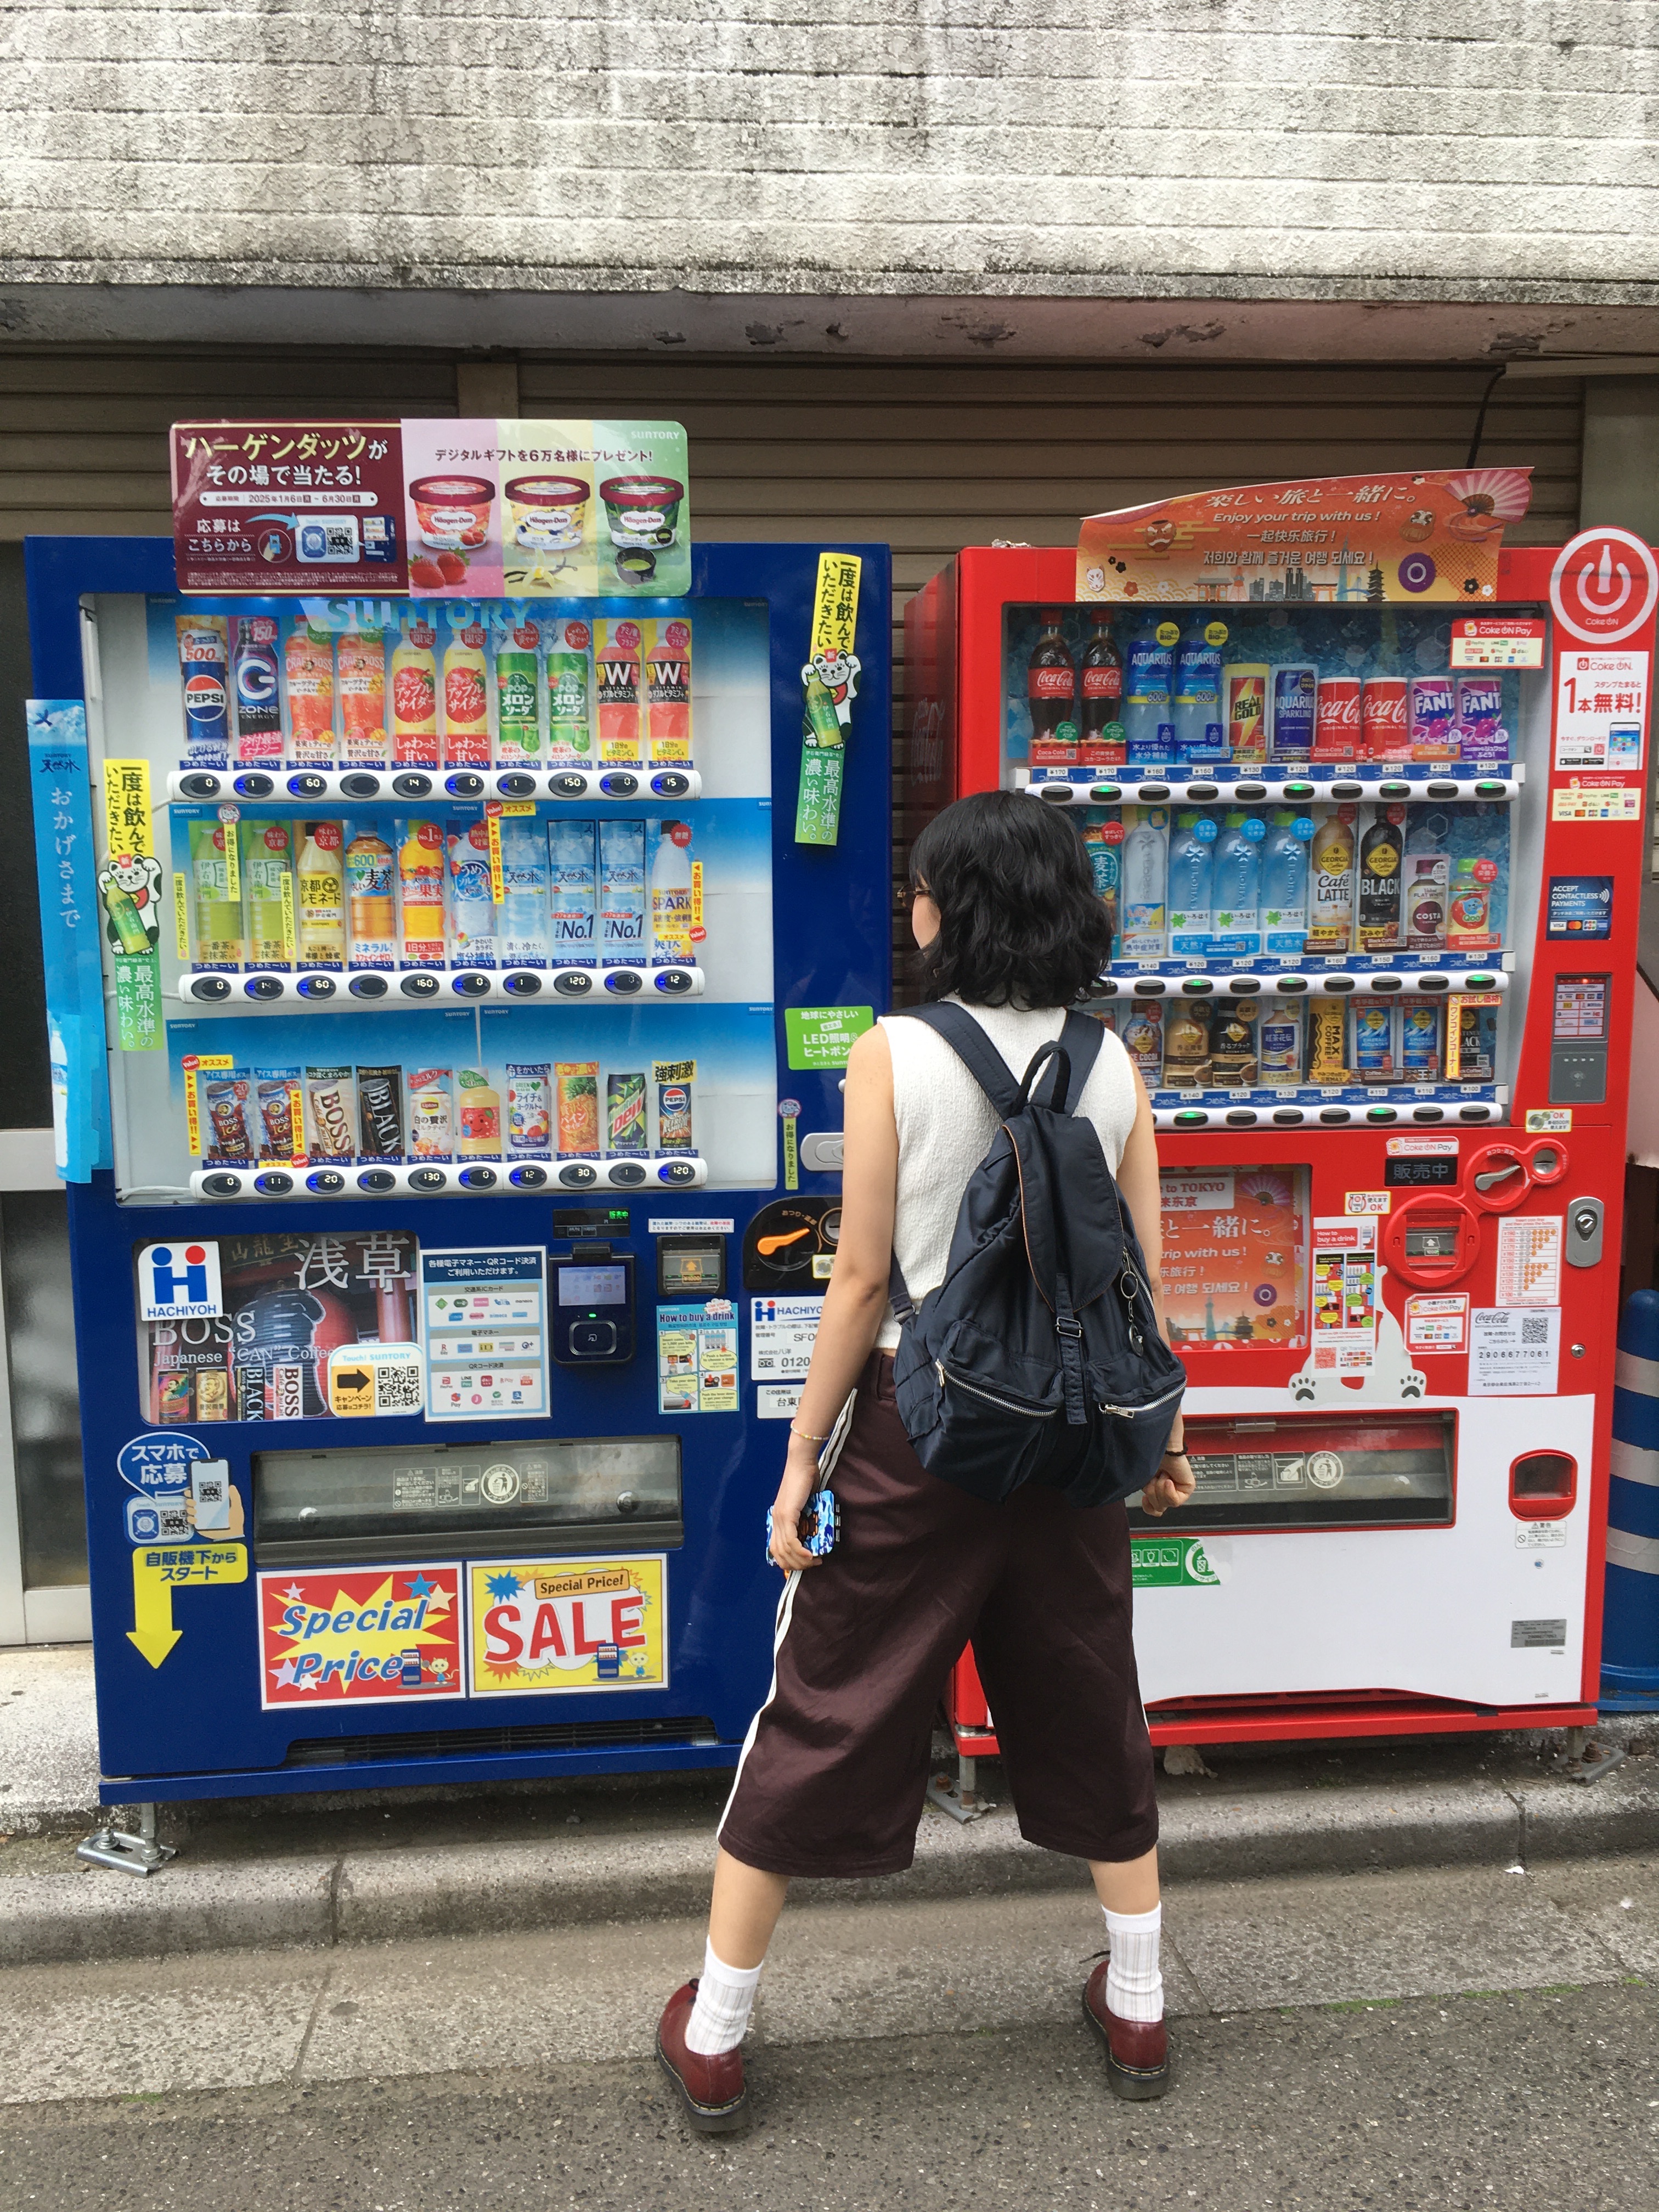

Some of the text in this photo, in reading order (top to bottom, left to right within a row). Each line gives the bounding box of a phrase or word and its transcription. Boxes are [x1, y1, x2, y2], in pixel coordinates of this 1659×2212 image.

[631, 430, 680, 439] SUNTORY
[184, 433, 388, 460] ハーゲンダッツが
[206, 465, 362, 486] その場で当たる!
[1206, 485, 1415, 507] 楽しい旅と一緒に。
[1213, 512, 1250, 524] Enjoy
[1252, 514, 1288, 524] your
[1290, 511, 1316, 523] trip
[1319, 510, 1352, 522] with
[1354, 512, 1372, 521] us
[196, 519, 241, 533] 応募は
[188, 538, 252, 552] こちらから
[1203, 551, 1237, 566] 저희와
[1242, 551, 1264, 566] 함께
[1267, 551, 1301, 565] 즐거운
[1305, 551, 1328, 565] 여행
[1330, 551, 1366, 565] 되세요
[818, 559, 838, 648] いただきたい
[835, 560, 857, 650] 一度は飲んで
[1516, 627, 1532, 636] Pay
[1132, 653, 1172, 666] AQUARIUS
[1180, 653, 1220, 665] AQUARIUS
[605, 664, 630, 685] W
[654, 664, 680, 685] W
[1037, 670, 1073, 687] Coca-Cola
[1084, 670, 1120, 687] Coca-Cola
[187, 693, 224, 703] PEPSI
[397, 696, 435, 713] サイダー
[502, 696, 534, 706] メロン
[552, 696, 585, 706] メロン
[1234, 697, 1261, 712] REAL
[506, 706, 532, 715] ソーダ
[1235, 707, 1261, 721] GOLD
[397, 736, 436, 749] しゅわっと
[447, 737, 488, 749] しゅわっと
[404, 750, 428, 761] 甘い
[1612, 780, 1626, 788] Pay
[803, 758, 822, 841] 濃い味わい。
[821, 759, 840, 843] 最高水準の
[106, 766, 123, 854] いただきたい
[121, 767, 146, 853] 一度は飲んで
[51, 787, 81, 928] おかげさまで
[227, 831, 238, 894] お得になりました
[354, 855, 374, 866] 600
[365, 868, 393, 891] 麦茶
[1318, 874, 1349, 888] Café
[1362, 878, 1400, 896] BLACK
[301, 893, 341, 904] レモネード
[1318, 888, 1349, 901] LATTE
[562, 915, 594, 940] No.1
[611, 915, 643, 939] No.1
[355, 943, 393, 952] ミネラル!
[117, 965, 135, 1048] 濃い味わい。
[134, 965, 155, 1047] 最高水準の
[800, 1011, 859, 1019] 地球にやさしい
[655, 1060, 693, 1082] 強刺激
[218, 1116, 239, 1126] BOSS
[269, 1115, 289, 1125] BOSS
[320, 1089, 351, 1151] BOSS
[368, 1086, 402, 1154] BLACK
[561, 1113, 586, 1125] パイン
[786, 1124, 795, 1183] お得になりました
[1393, 1164, 1448, 1180] 販売中
[1166, 1182, 1225, 1193] to TOKYO
[1185, 1248, 1218, 1258] with
[1222, 1248, 1240, 1257] us
[293, 1234, 411, 1294] 浅草
[448, 1267, 518, 1277] ご利用いただけます。
[147, 1305, 217, 1318] HACHIYOH
[660, 1314, 676, 1322] How
[690, 1312, 704, 1322] buy
[712, 1312, 735, 1321] drink
[153, 1310, 257, 1346] BOSS
[154, 1351, 223, 1367] Japanese
[369, 1352, 411, 1361] SUNTORY
[246, 1367, 264, 1421] BLACK
[131, 1444, 199, 1462] スマホで
[140, 1464, 187, 1485] 応募
[146, 1551, 236, 1567] 自販機下から
[160, 1566, 218, 1581] スタート
[540, 1575, 624, 1595] Special Price!
[279, 1598, 429, 1640] Special
[482, 1595, 646, 1663] SALE
[294, 1650, 403, 1685] Price
